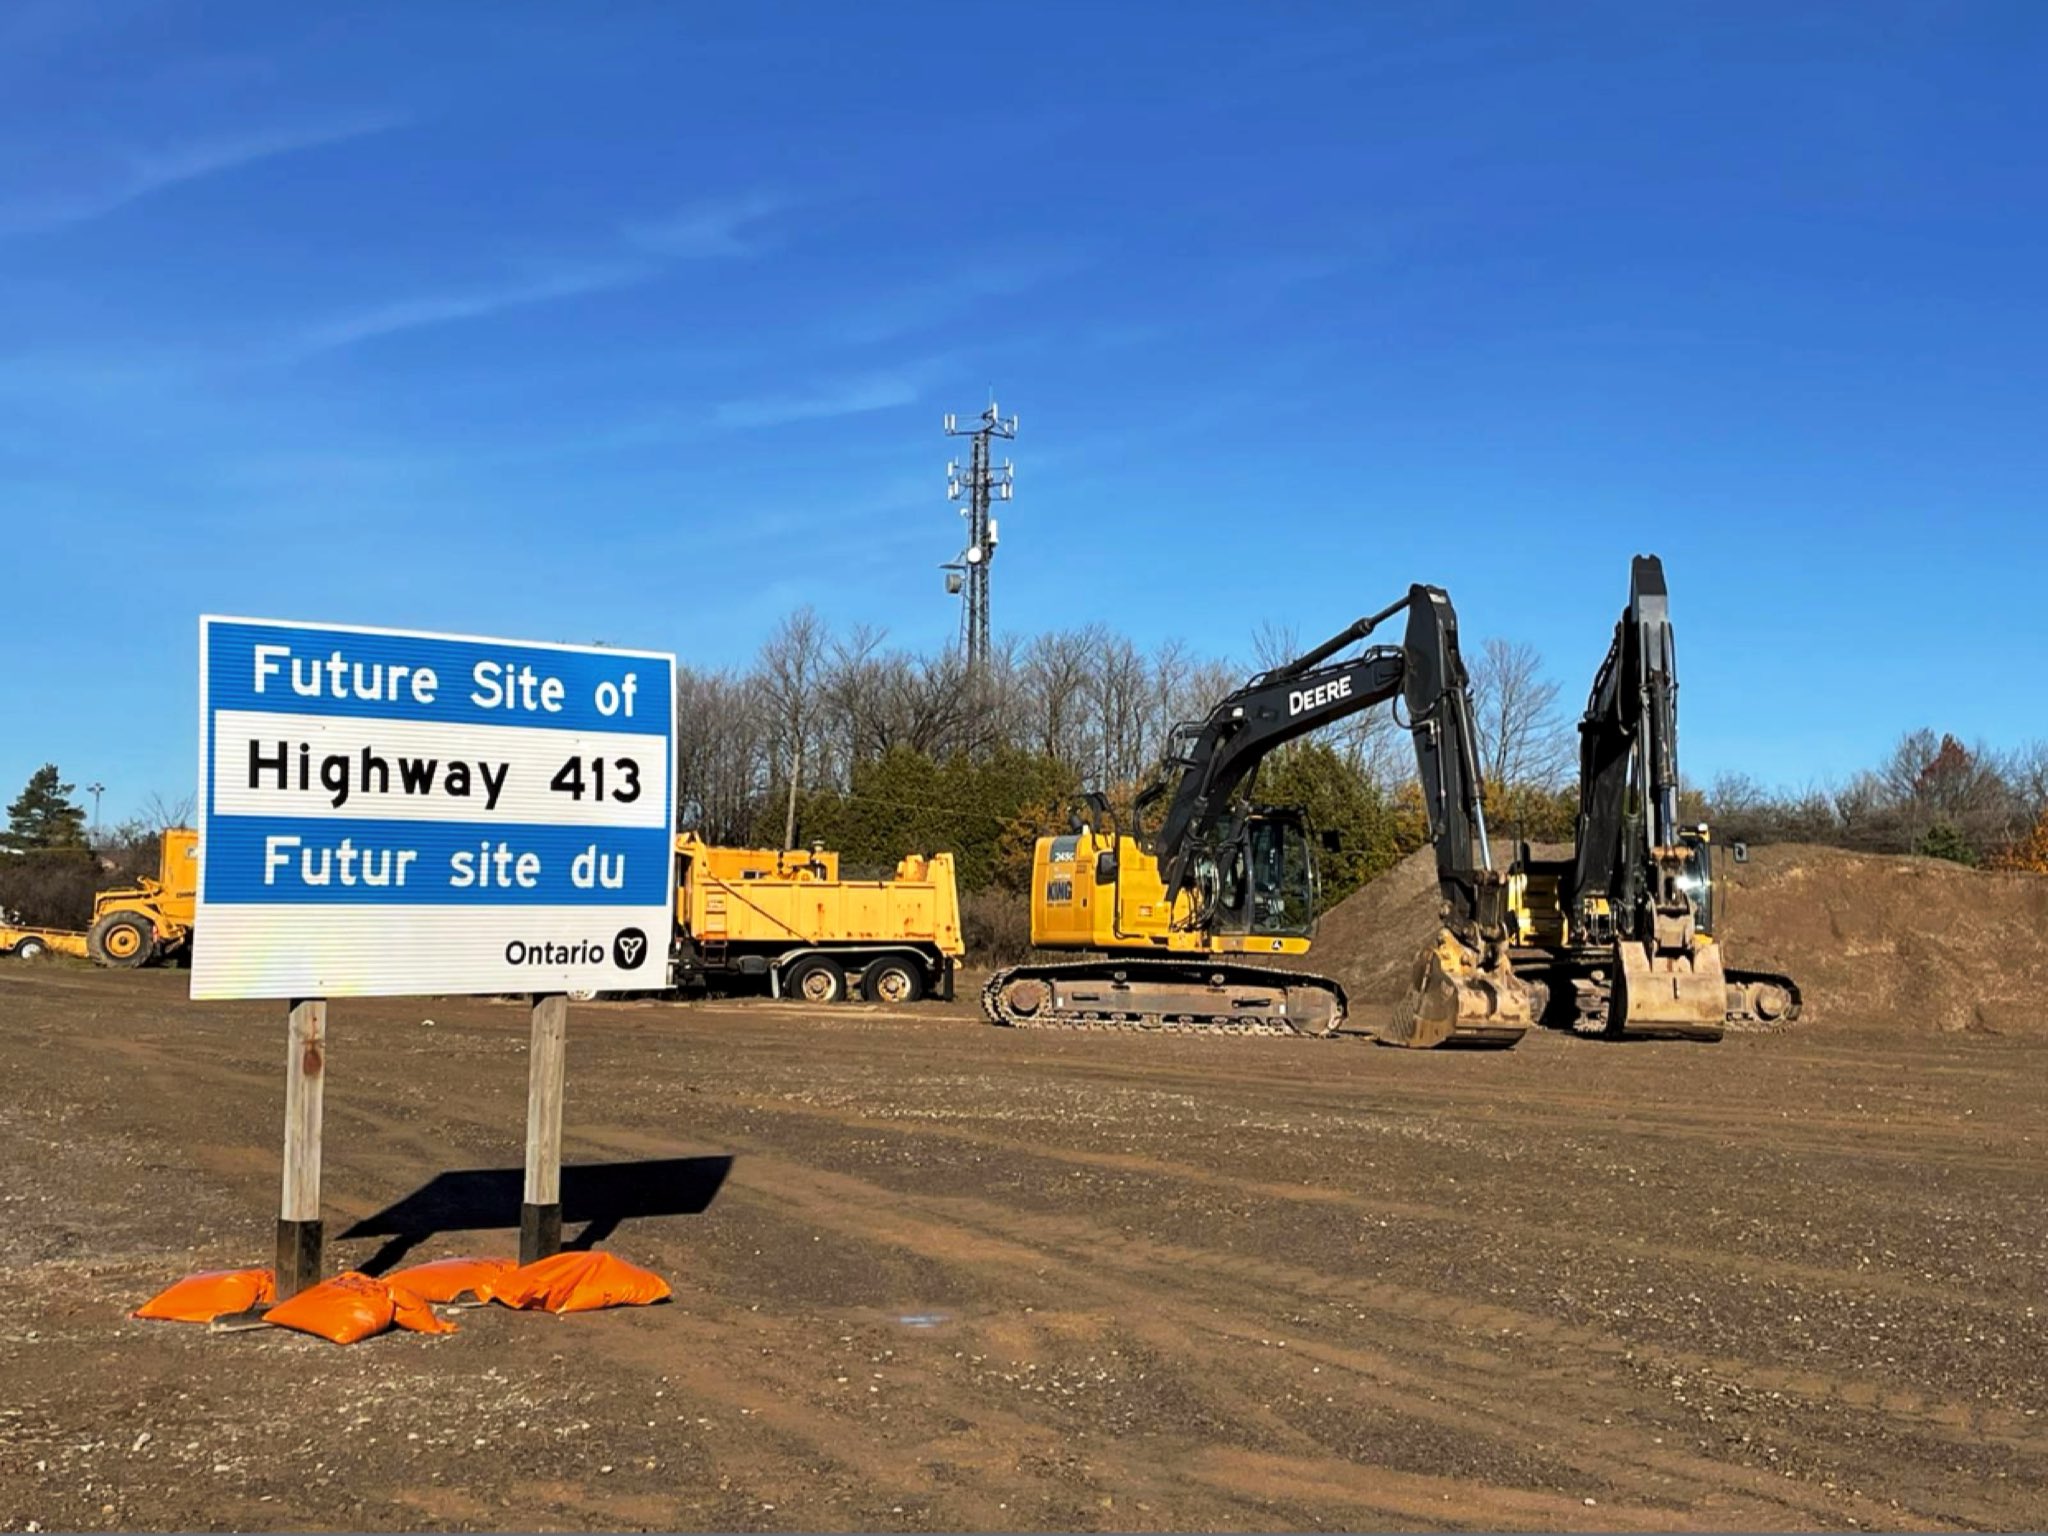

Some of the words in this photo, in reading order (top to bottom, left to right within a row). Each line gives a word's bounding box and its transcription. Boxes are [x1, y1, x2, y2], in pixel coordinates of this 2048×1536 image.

[254, 644, 438, 703] Future
[470, 661, 565, 712] Site
[594, 673, 637, 717] of
[1289, 675, 1352, 716] DEERE
[248, 739, 510, 811] Highway
[550, 755, 641, 803] 413
[264, 836, 417, 886] Futur
[449, 841, 541, 889] site
[571, 844, 625, 889] du
[505, 940, 605, 965] Ontario
